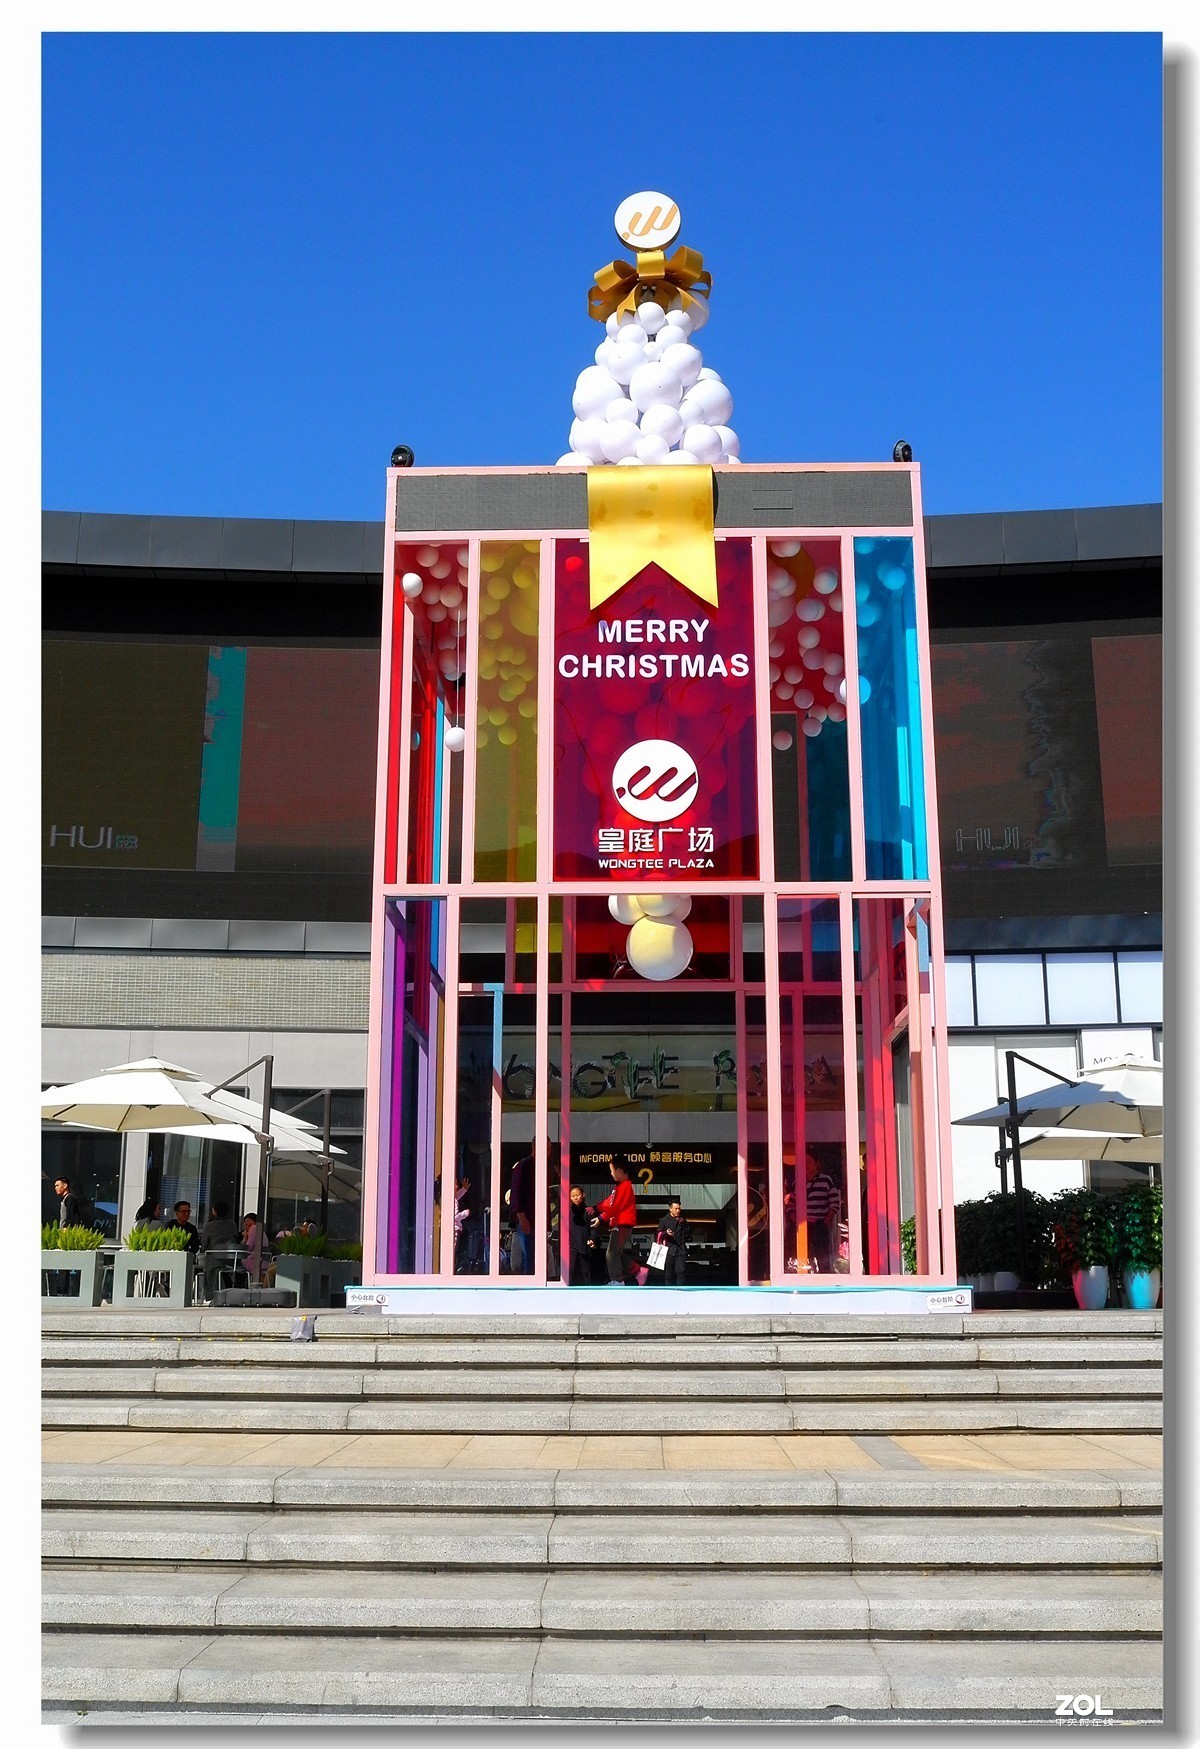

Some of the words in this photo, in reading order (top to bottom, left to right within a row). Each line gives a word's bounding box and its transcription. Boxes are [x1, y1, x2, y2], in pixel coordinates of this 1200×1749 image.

[598, 619, 710, 644] MERRY
[558, 653, 750, 678] CHRISTMAS
[50, 824, 113, 849] HUI
[598, 827, 714, 853] 皇庭广场
[598, 858, 664, 869] WONGTEE
[668, 858, 714, 869] PLAZA
[579, 1153, 646, 1163] INFORMION
[650, 1152, 712, 1163] 顾客服务中心
